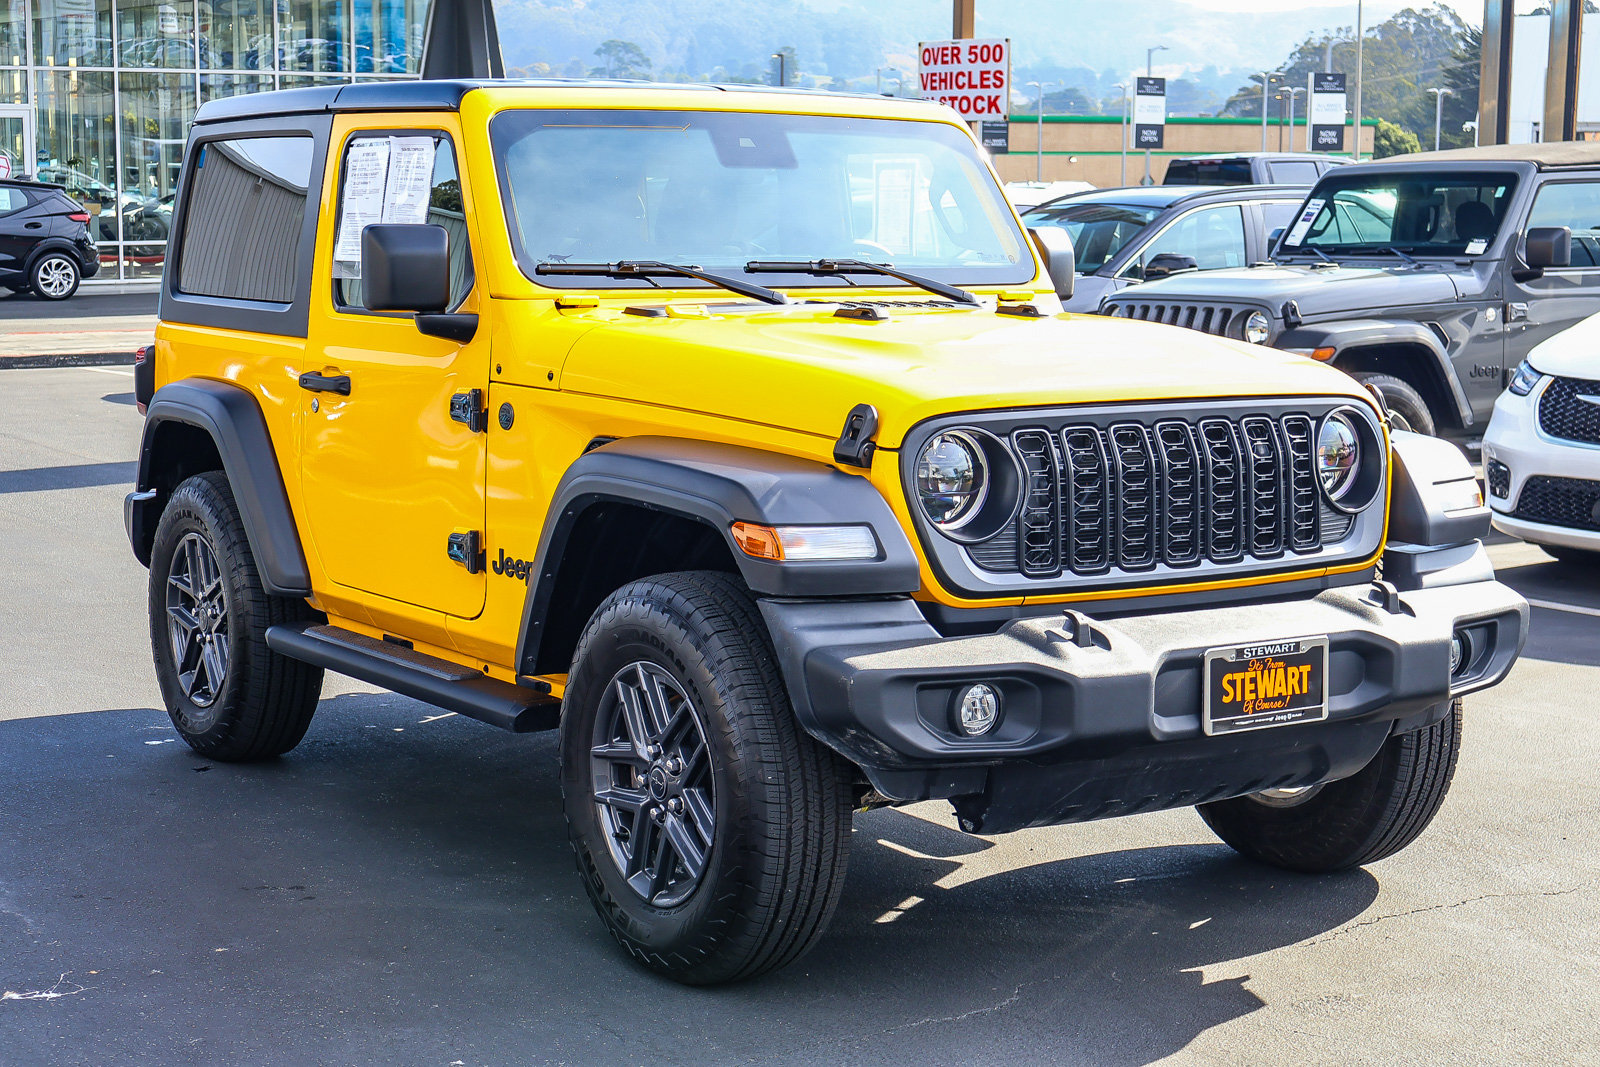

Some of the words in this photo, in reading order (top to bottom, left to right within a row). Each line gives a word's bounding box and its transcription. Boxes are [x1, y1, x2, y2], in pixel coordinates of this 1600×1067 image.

[922, 46, 962, 66] OVER
[967, 44, 1003, 64] 500
[920, 69, 1004, 91] VEHICLES
[1469, 363, 1500, 379] Jeep
[1243, 642, 1296, 659] STEWART
[1265, 657, 1286, 670] From
[1222, 664, 1312, 704] STEWART
[1243, 699, 1255, 715] Of
